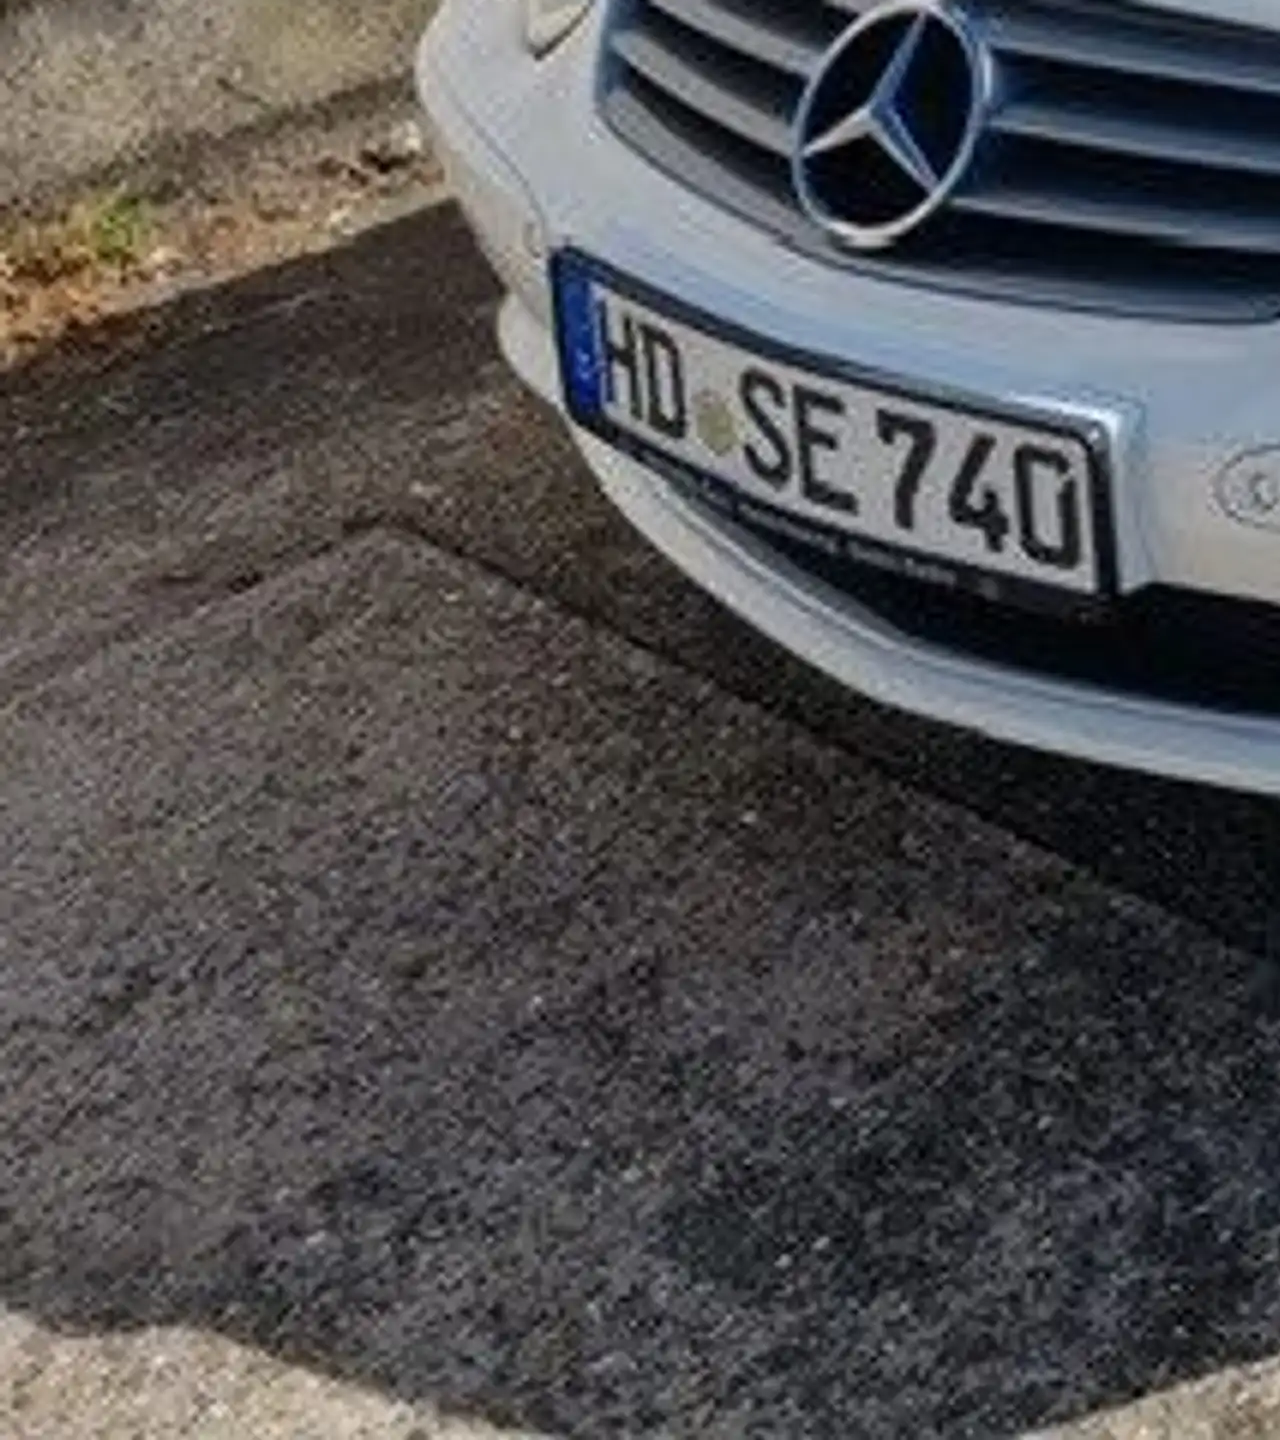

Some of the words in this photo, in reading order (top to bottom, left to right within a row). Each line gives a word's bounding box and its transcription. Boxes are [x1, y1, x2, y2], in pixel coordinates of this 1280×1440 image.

[597, 299, 686, 439] HD
[738, 367, 858, 515] SE
[877, 410, 1081, 570] 740
